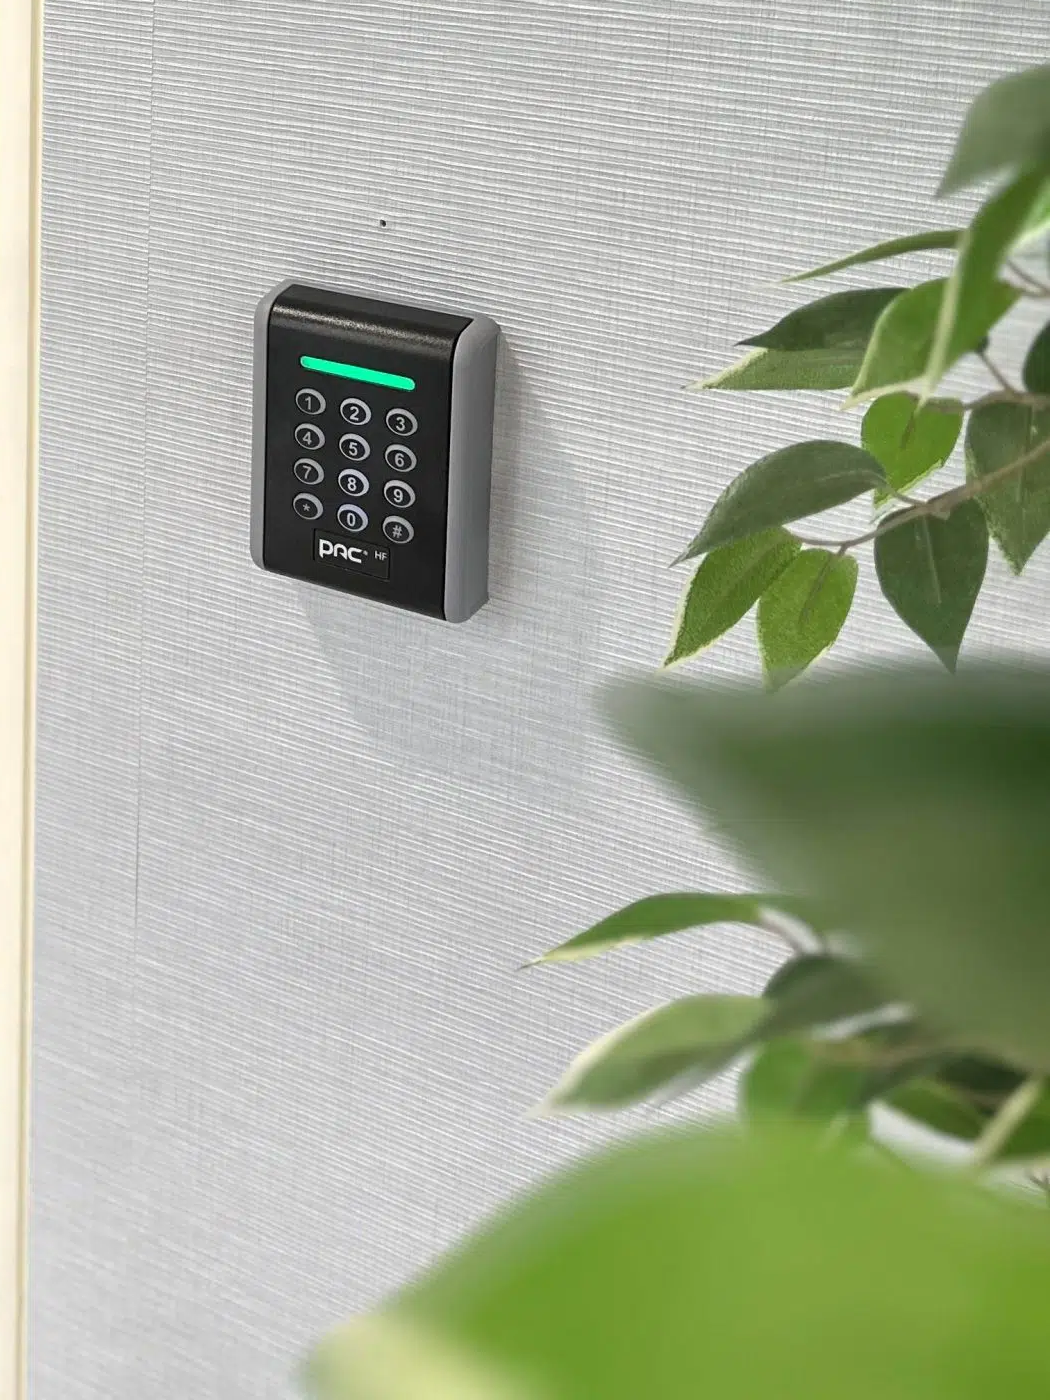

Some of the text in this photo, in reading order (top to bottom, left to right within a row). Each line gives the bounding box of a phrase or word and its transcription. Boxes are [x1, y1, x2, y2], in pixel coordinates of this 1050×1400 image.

[304, 396, 312, 411] 1
[349, 406, 360, 421] 2
[395, 416, 406, 432] 3
[302, 431, 312, 445] 4
[348, 442, 358, 456] 5
[394, 453, 405, 468] 6
[302, 465, 312, 480] 7
[347, 477, 357, 492] 8
[393, 488, 404, 503] 9
[346, 512, 356, 527] 0
[318, 538, 388, 564] PAC HF
